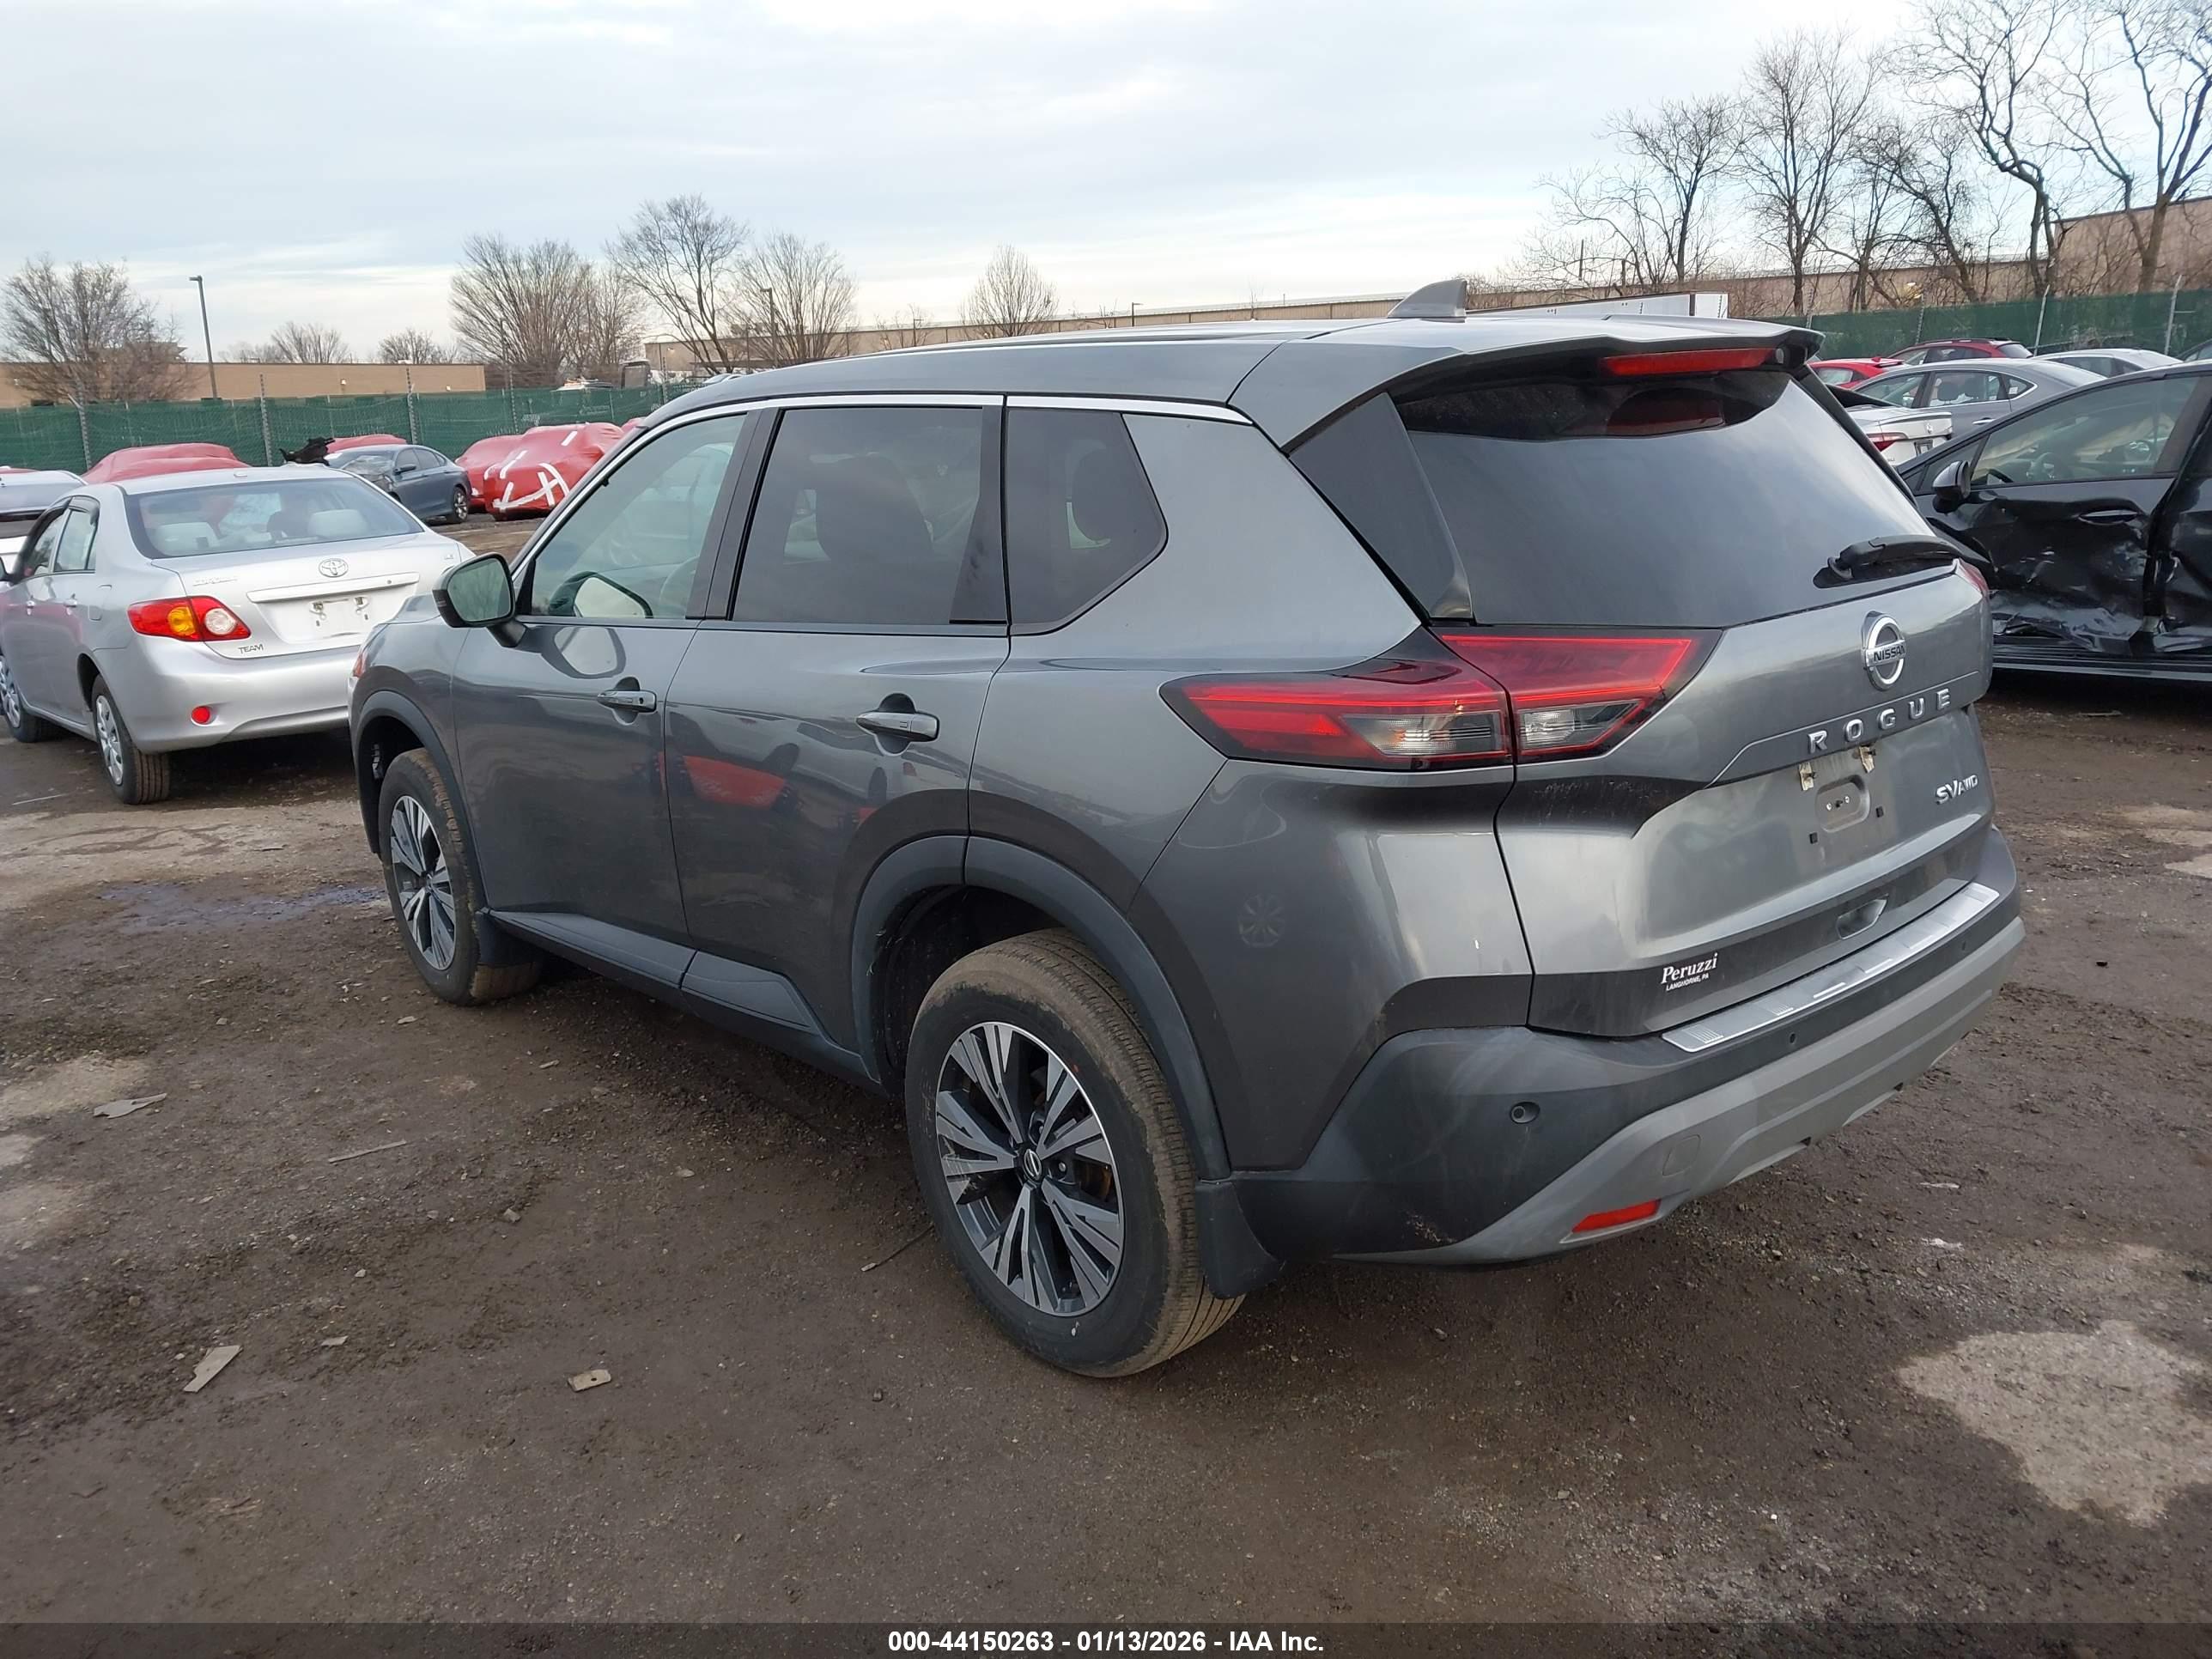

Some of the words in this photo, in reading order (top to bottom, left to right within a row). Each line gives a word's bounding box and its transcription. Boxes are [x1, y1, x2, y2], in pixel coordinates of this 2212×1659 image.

[238, 643, 264, 654] TEAM
[1873, 644, 1905, 662] NISSAN
[1808, 689, 1951, 754] ROGUE
[1661, 952, 1718, 984] Peruzzi
